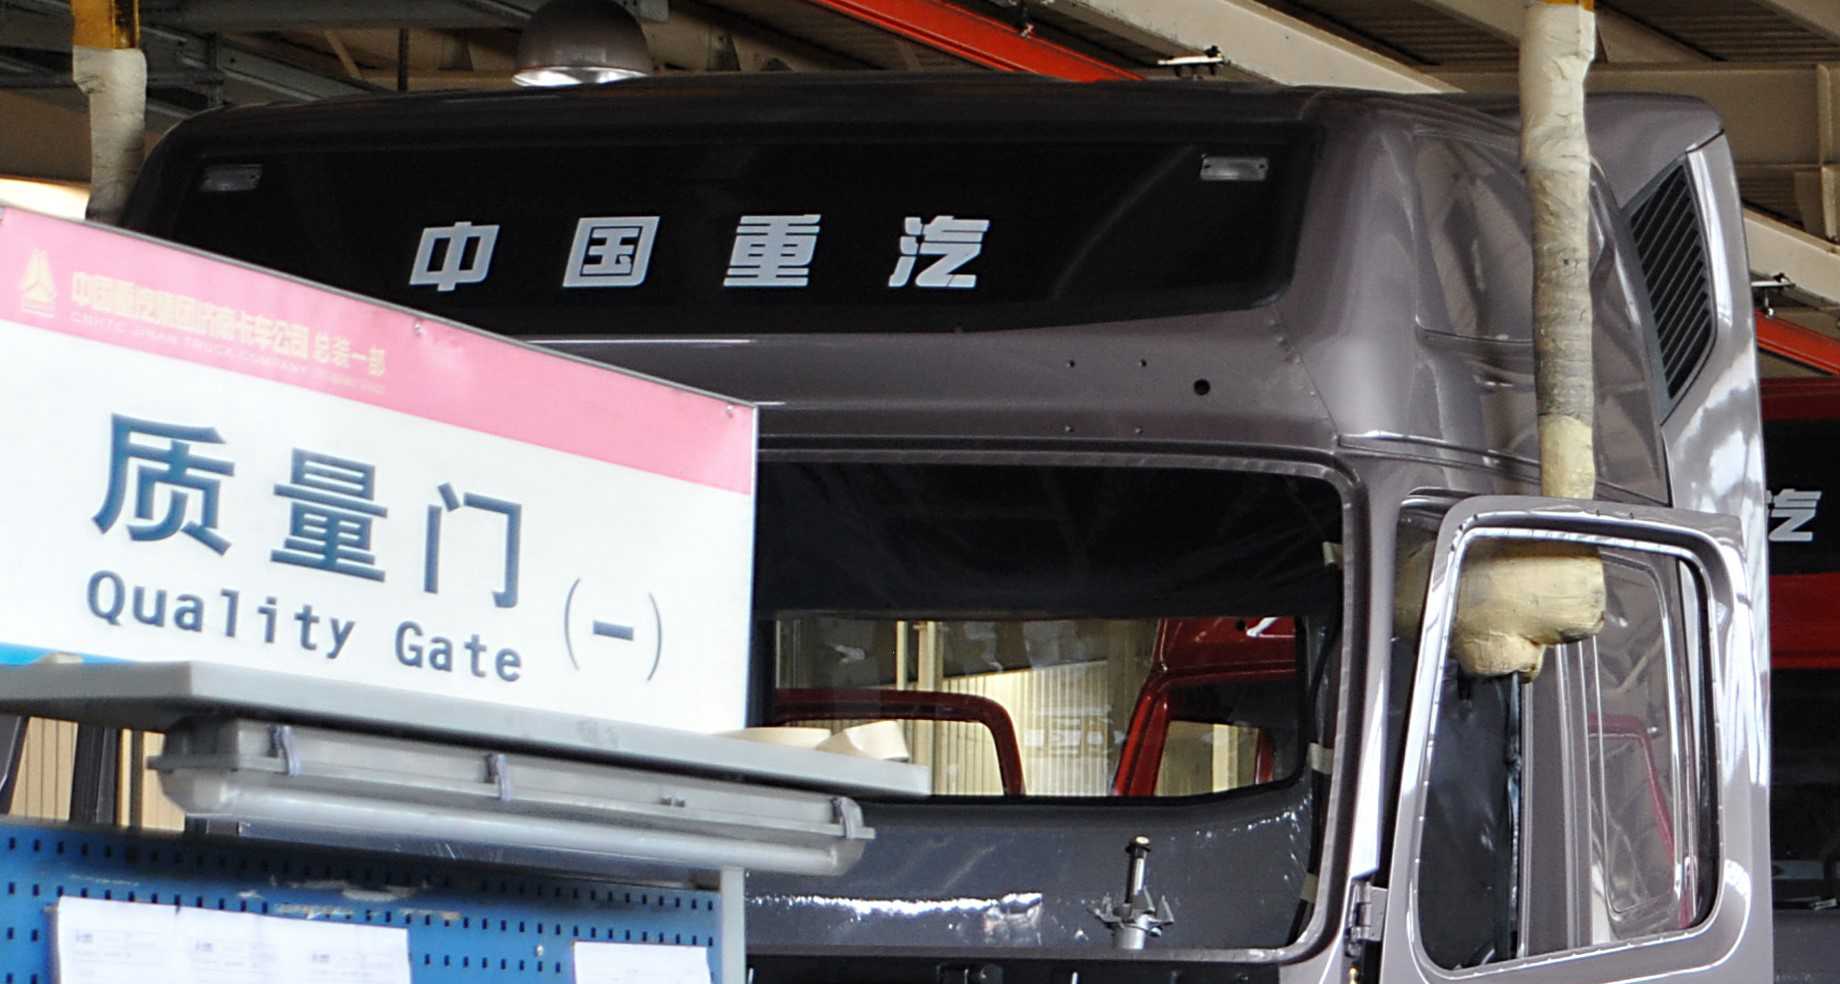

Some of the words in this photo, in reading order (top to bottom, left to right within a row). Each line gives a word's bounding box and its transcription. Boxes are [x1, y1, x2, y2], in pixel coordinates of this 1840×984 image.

[410, 214, 990, 292] 中国重汽
[86, 569, 356, 660] Quality
[395, 621, 522, 682] Gate
